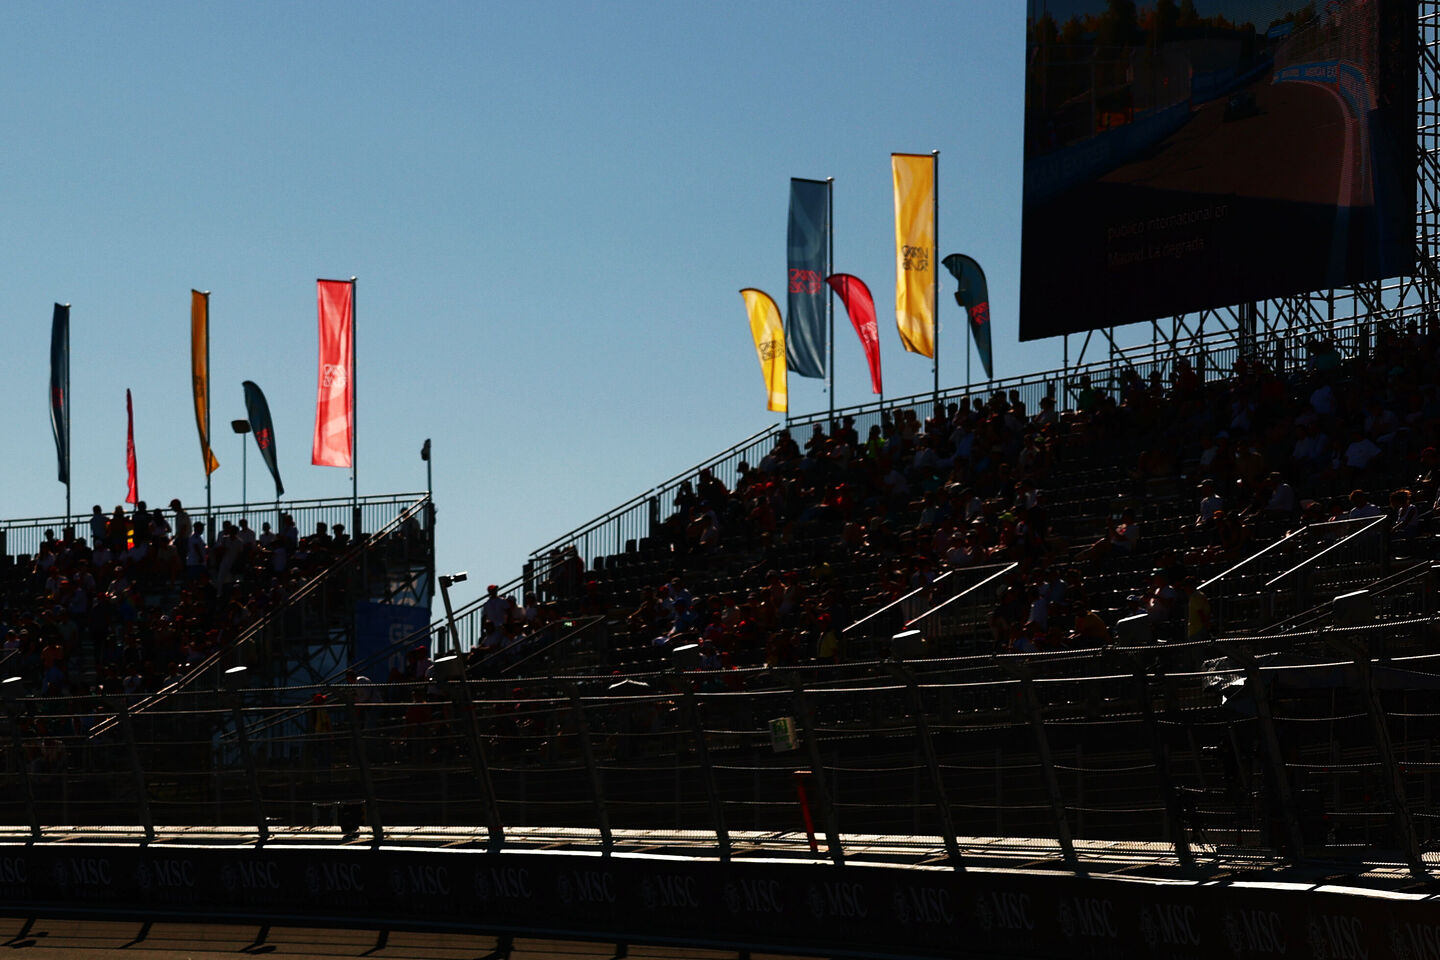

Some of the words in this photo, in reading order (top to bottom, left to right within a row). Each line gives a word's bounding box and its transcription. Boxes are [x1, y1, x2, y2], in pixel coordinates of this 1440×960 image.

[70, 858, 113, 886] MSC
[152, 859, 197, 888] MSC
[238, 861, 281, 889] MSC
[320, 862, 366, 891] MSC
[407, 865, 451, 896] MSC
[489, 867, 534, 899] MSC
[573, 871, 617, 904] MSC
[656, 874, 700, 908] MSC
[739, 879, 785, 913] MSC
[823, 881, 869, 918] MSC
[908, 886, 954, 926] MSC
[991, 891, 1036, 931] MSC
[1073, 896, 1119, 938] MSC
[1155, 903, 1201, 947] MSC
[1239, 908, 1288, 955] MSC
[1321, 914, 1369, 960] MSC
